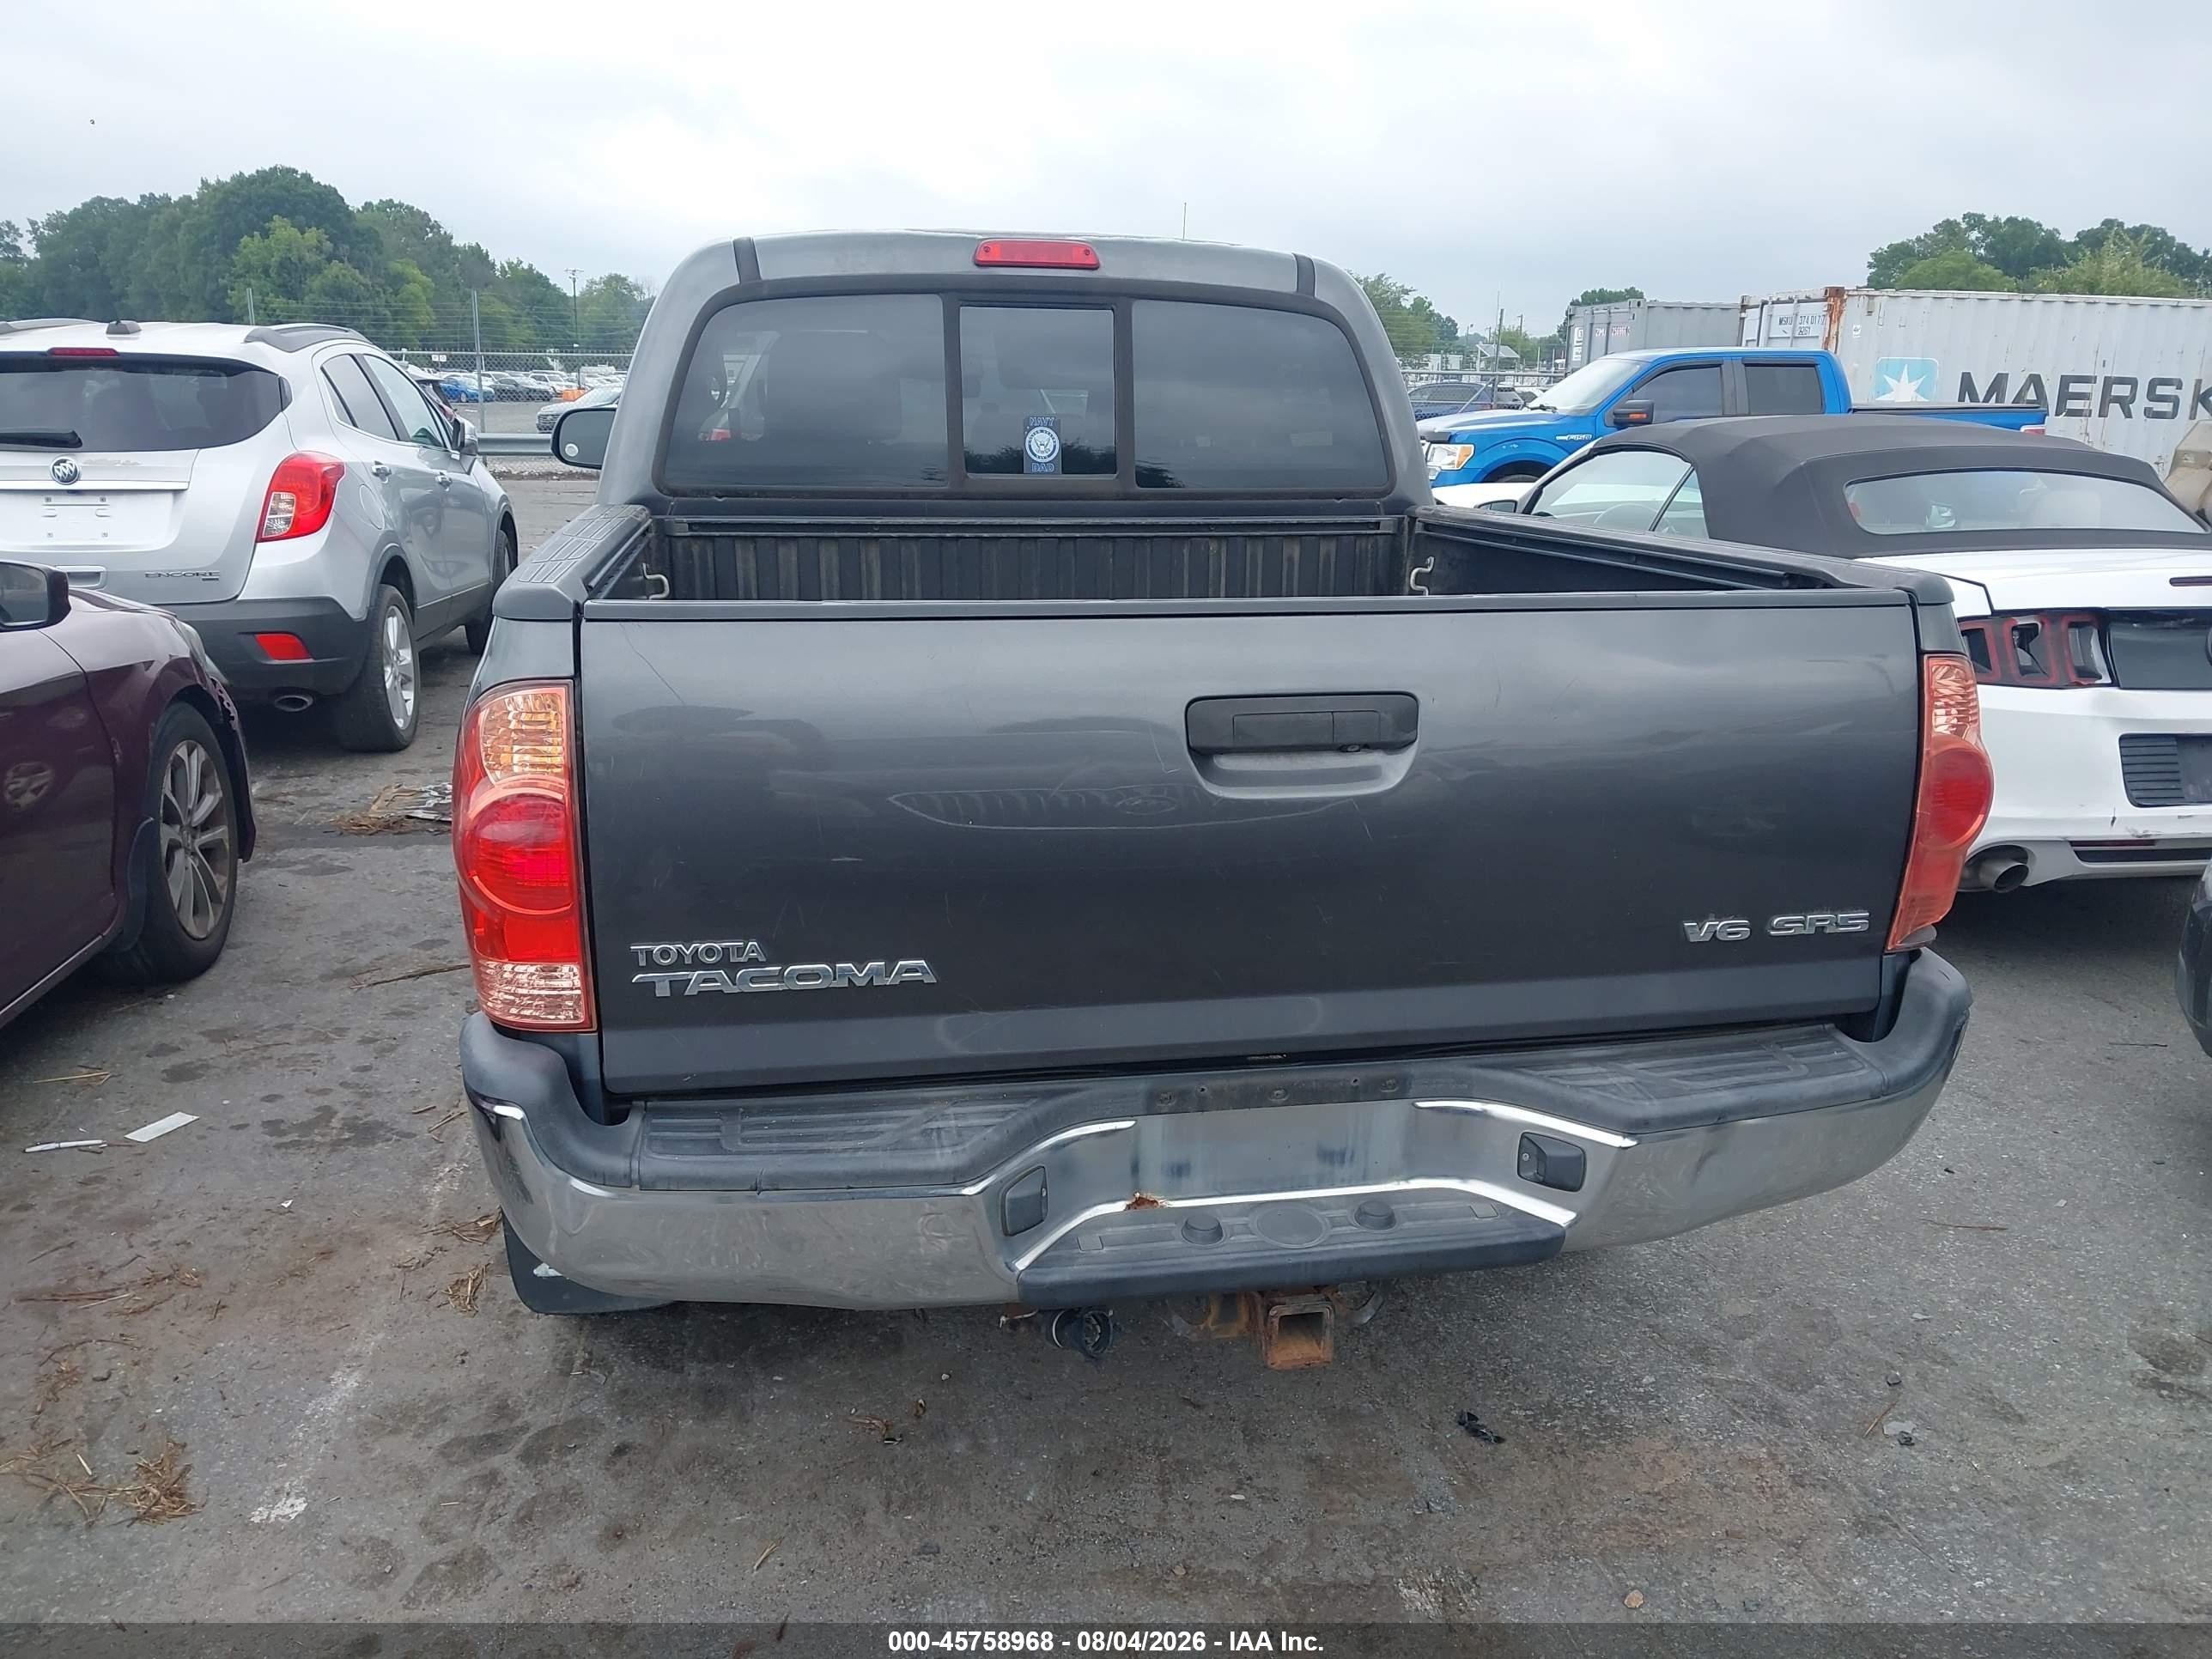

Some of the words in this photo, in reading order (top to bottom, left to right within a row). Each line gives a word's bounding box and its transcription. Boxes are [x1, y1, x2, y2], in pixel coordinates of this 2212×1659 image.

[1958, 371, 2212, 421] MAERSK
[1030, 416, 1054, 426] NAVY
[1031, 462, 1054, 472] DAD
[1683, 920, 1751, 943] V6
[1769, 912, 1870, 936] SR5
[630, 940, 766, 967] TOYOTA
[631, 959, 938, 997] TACOMA
